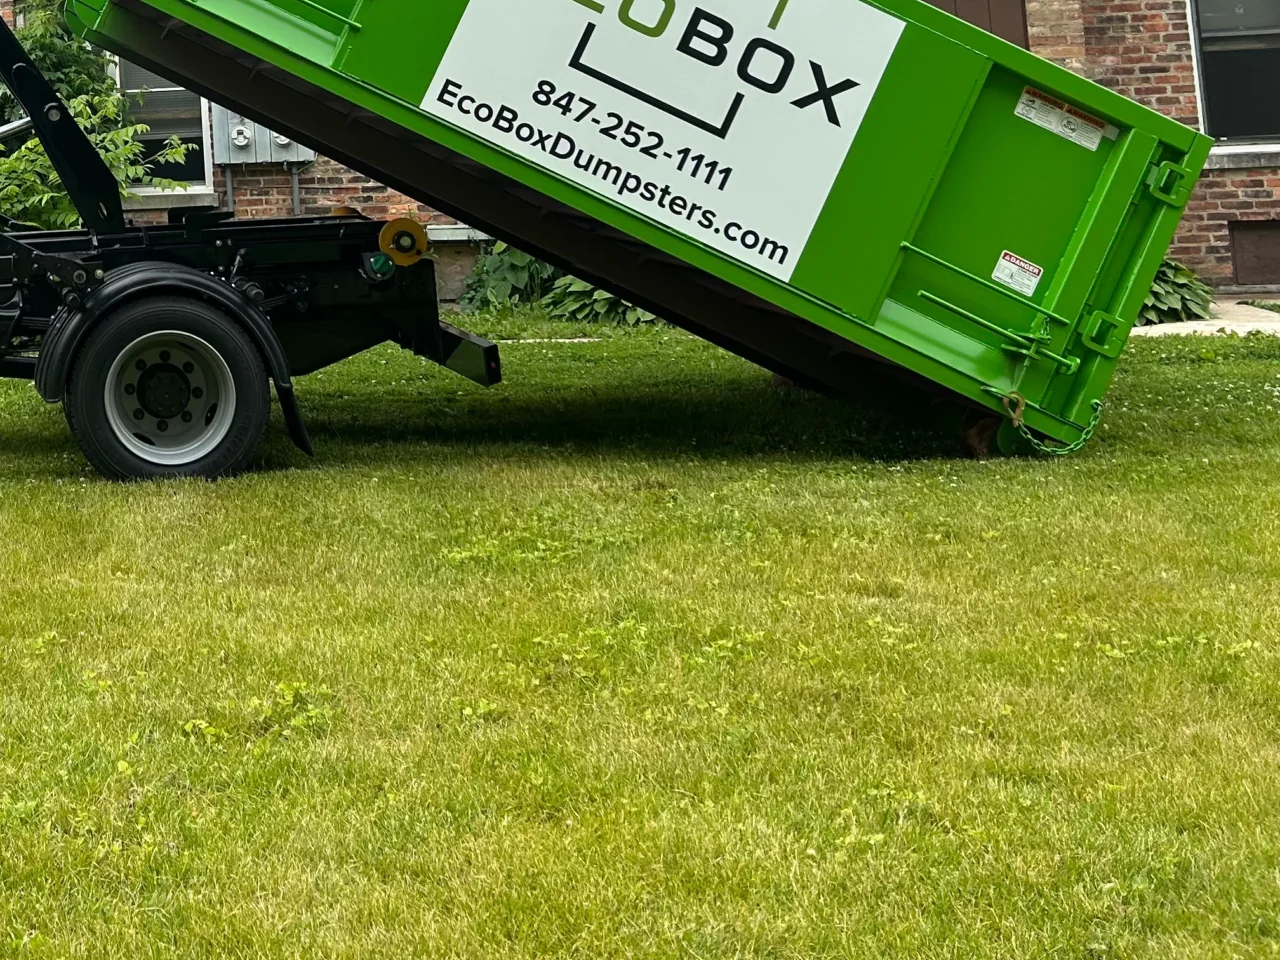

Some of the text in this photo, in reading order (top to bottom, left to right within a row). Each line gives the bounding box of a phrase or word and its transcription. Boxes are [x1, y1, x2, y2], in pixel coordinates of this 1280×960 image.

[435, 78, 790, 266] EcoBoxDumpsters.com
[532, 79, 734, 192] 847-252-1111
[1010, 254, 1039, 275] DANGER
